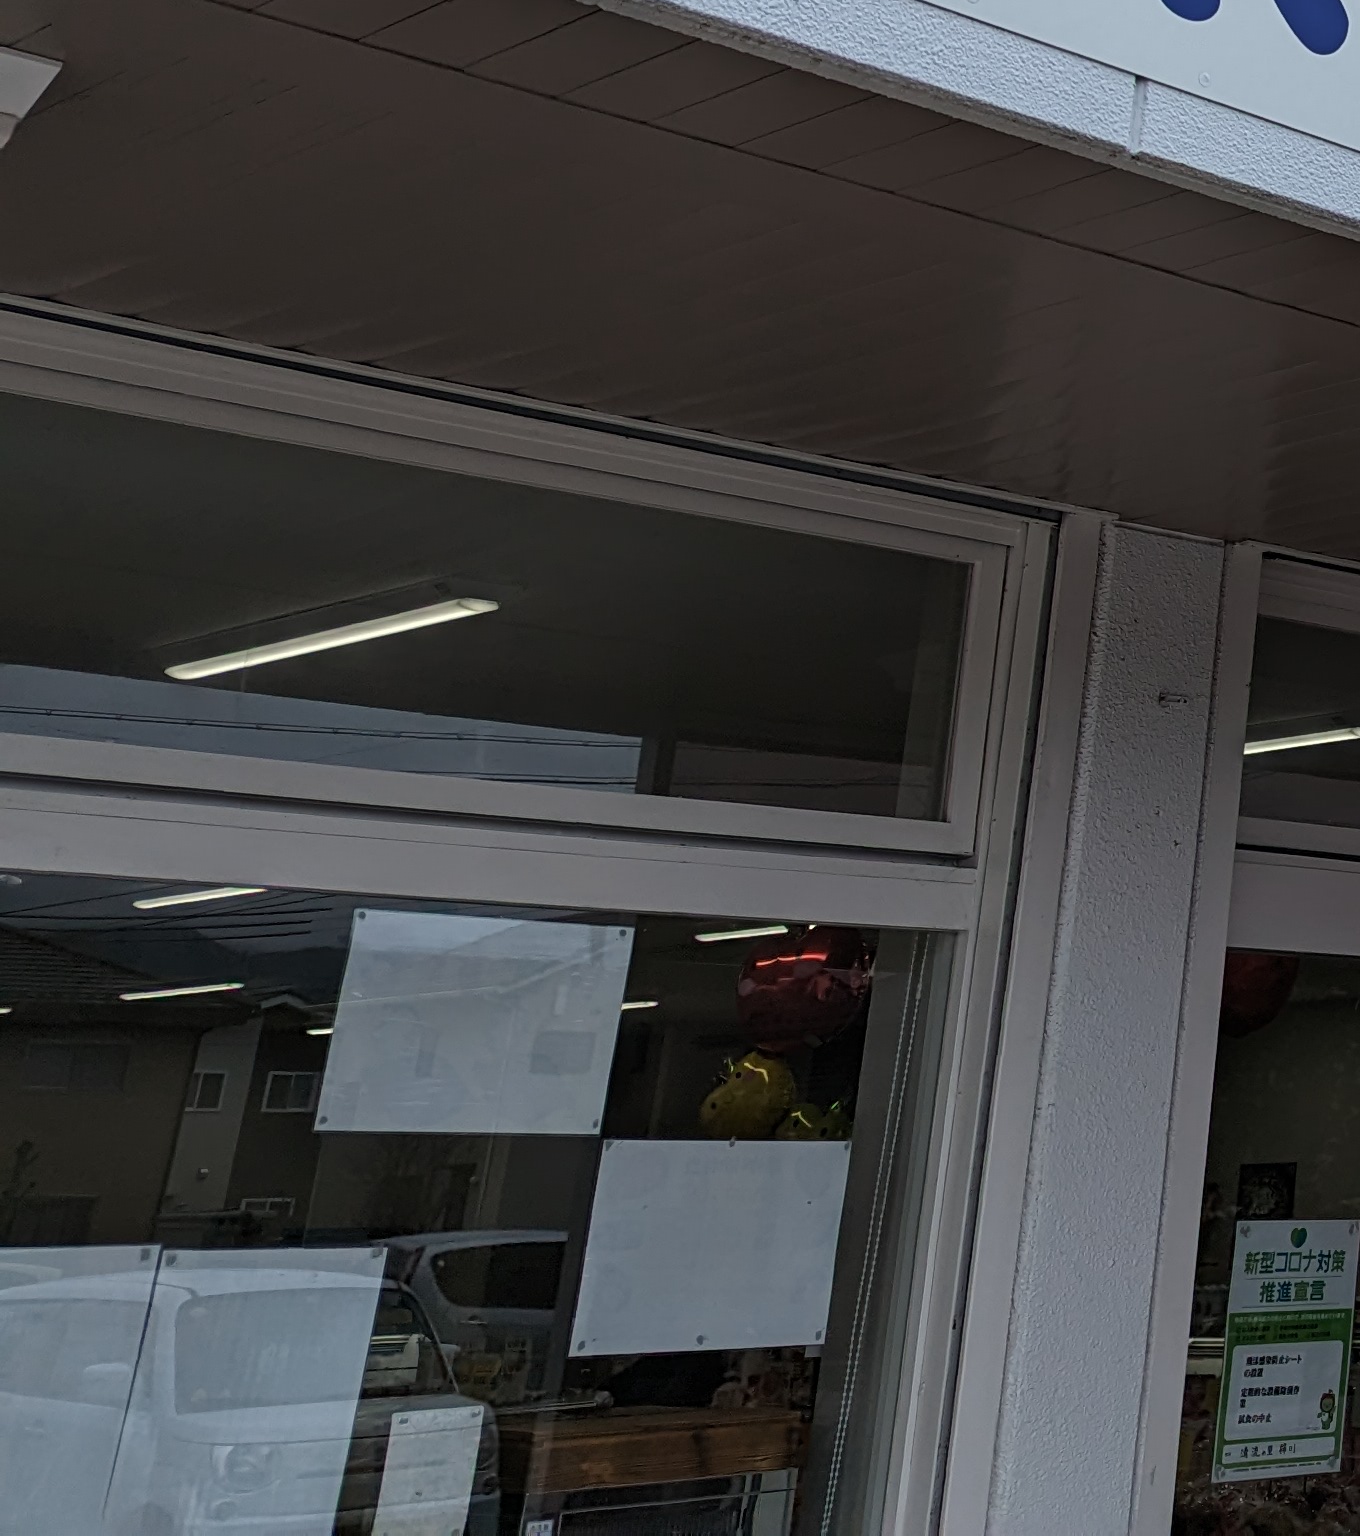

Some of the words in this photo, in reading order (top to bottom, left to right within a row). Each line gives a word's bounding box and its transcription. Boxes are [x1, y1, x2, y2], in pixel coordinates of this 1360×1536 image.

[1244, 1249, 1346, 1275] 新型コロナ対策
[1259, 1280, 1326, 1303] 推進宣言
